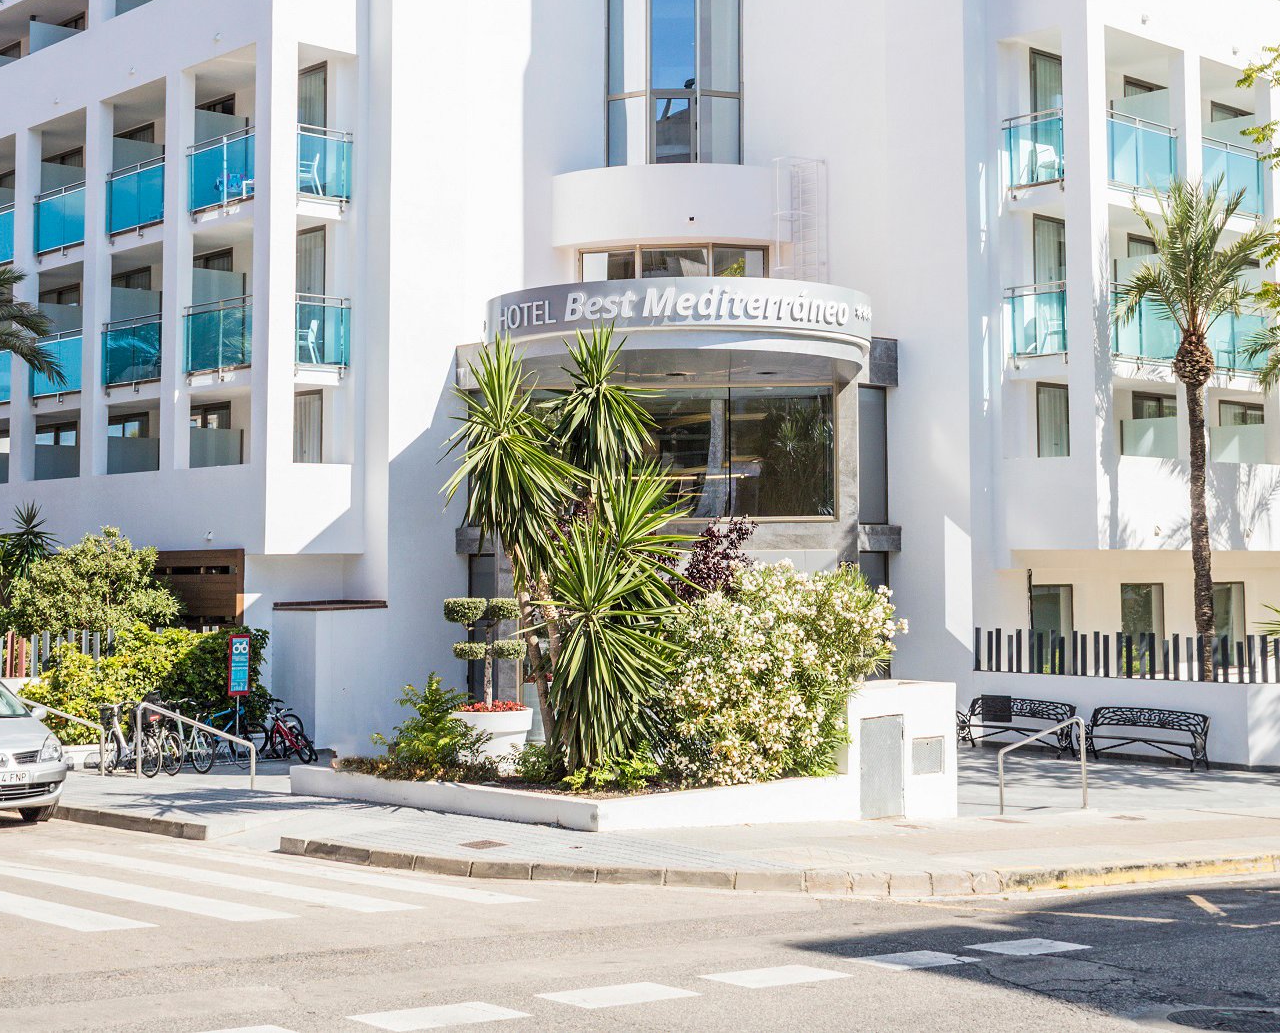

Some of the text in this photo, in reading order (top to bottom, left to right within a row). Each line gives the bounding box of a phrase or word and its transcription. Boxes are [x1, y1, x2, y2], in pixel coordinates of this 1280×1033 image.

[499, 285, 850, 330] HOTEL Best Mediterráneo
[10, 772, 27, 782] FNP
